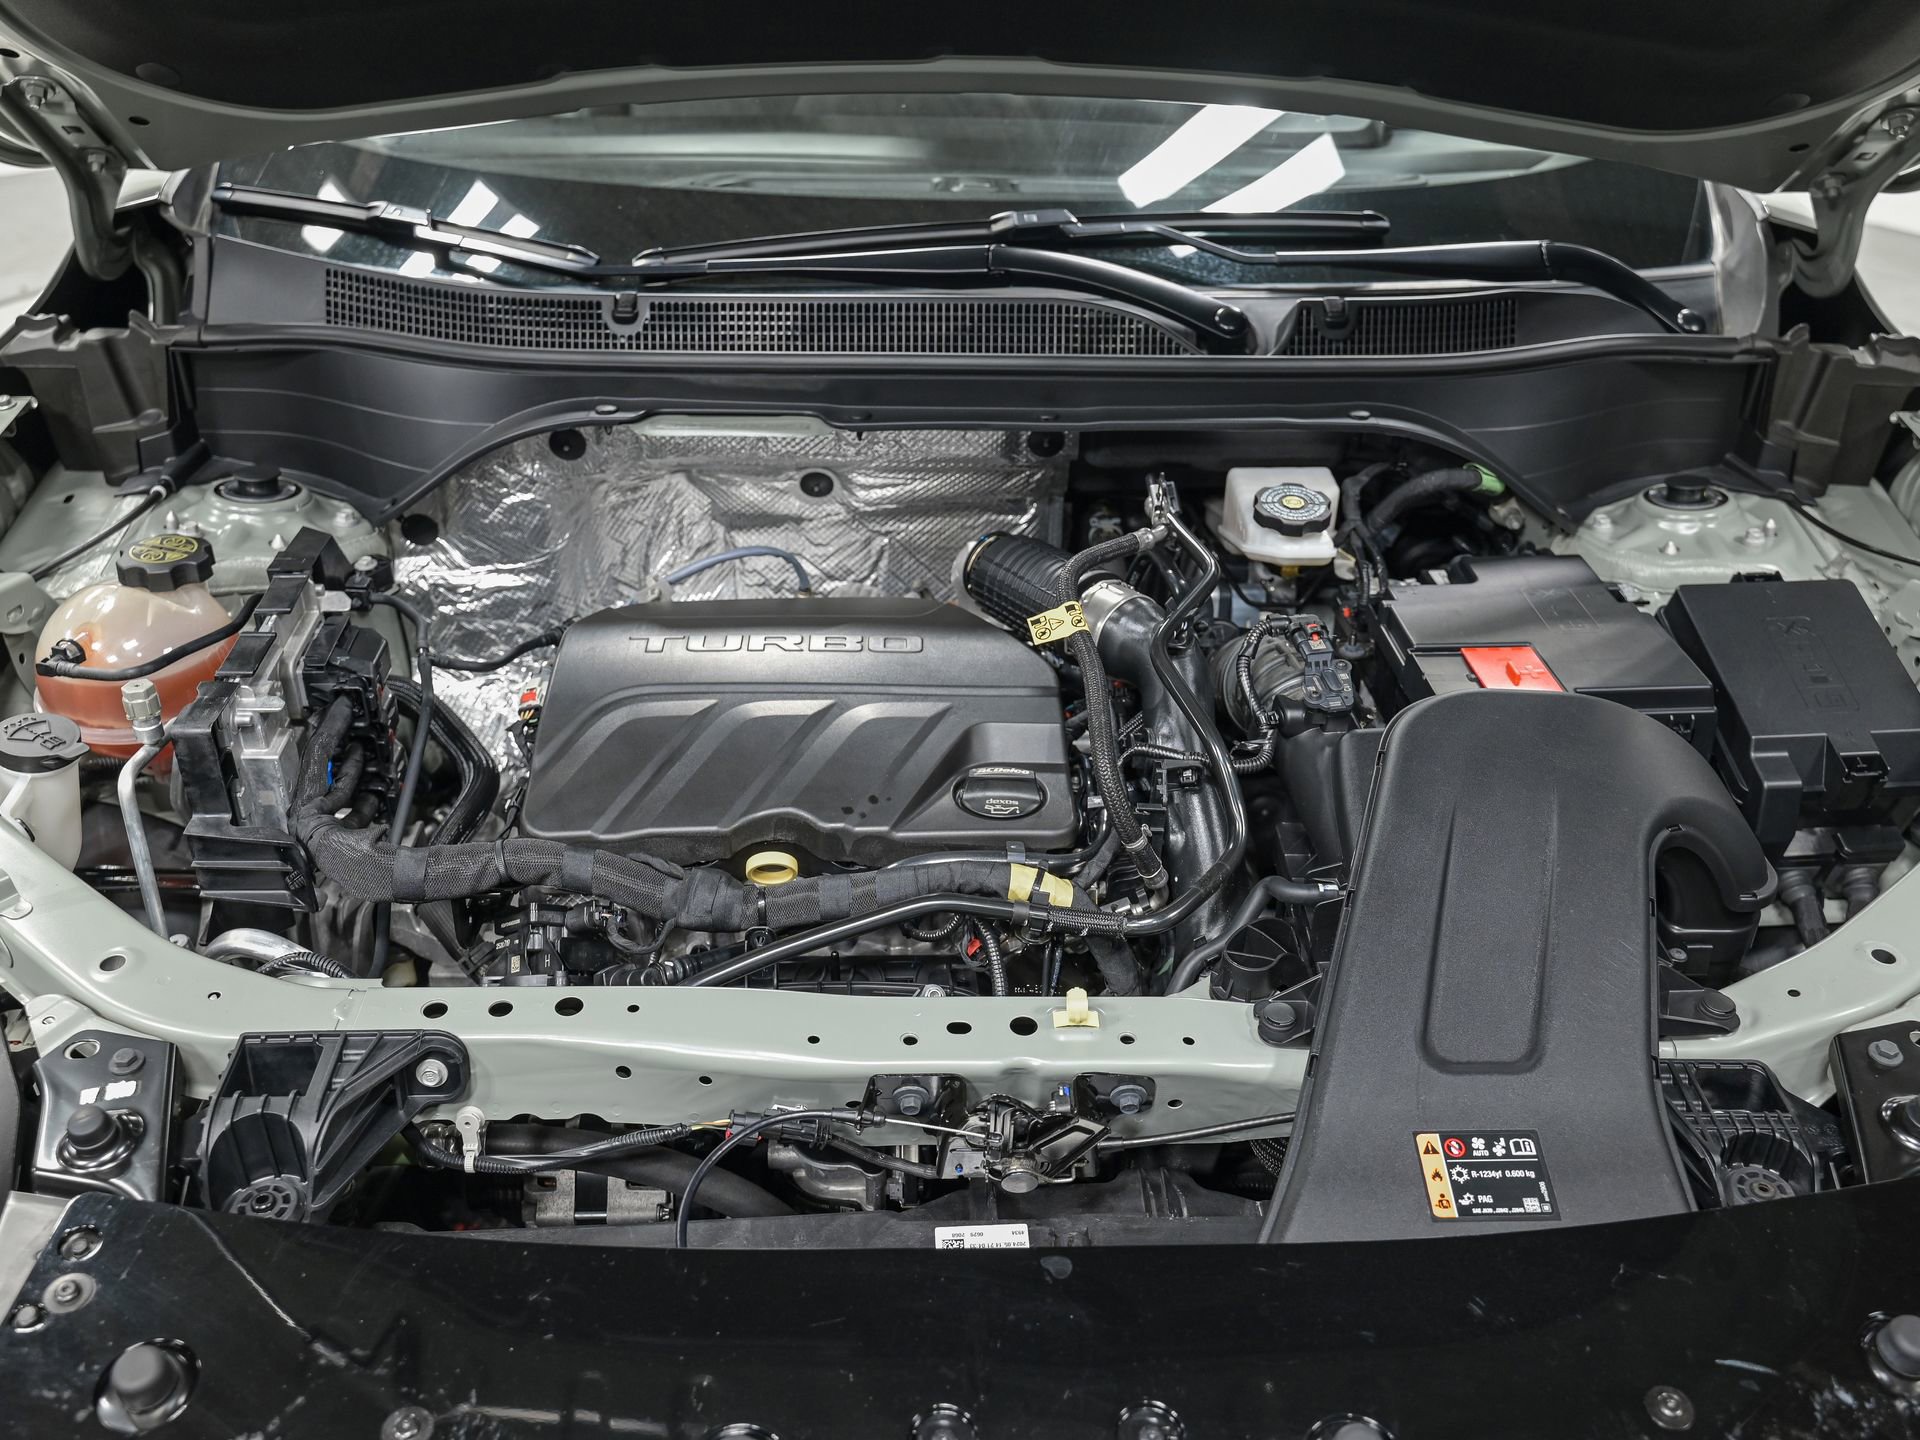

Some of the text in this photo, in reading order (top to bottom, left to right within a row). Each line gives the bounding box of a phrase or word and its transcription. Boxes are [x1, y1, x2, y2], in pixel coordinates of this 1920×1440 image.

[629, 635, 923, 653] TURBO
[1471, 1170, 1502, 1179] R-1234yf
[1525, 1170, 1536, 1178] kg
[1478, 1195, 1494, 1203] PAG
